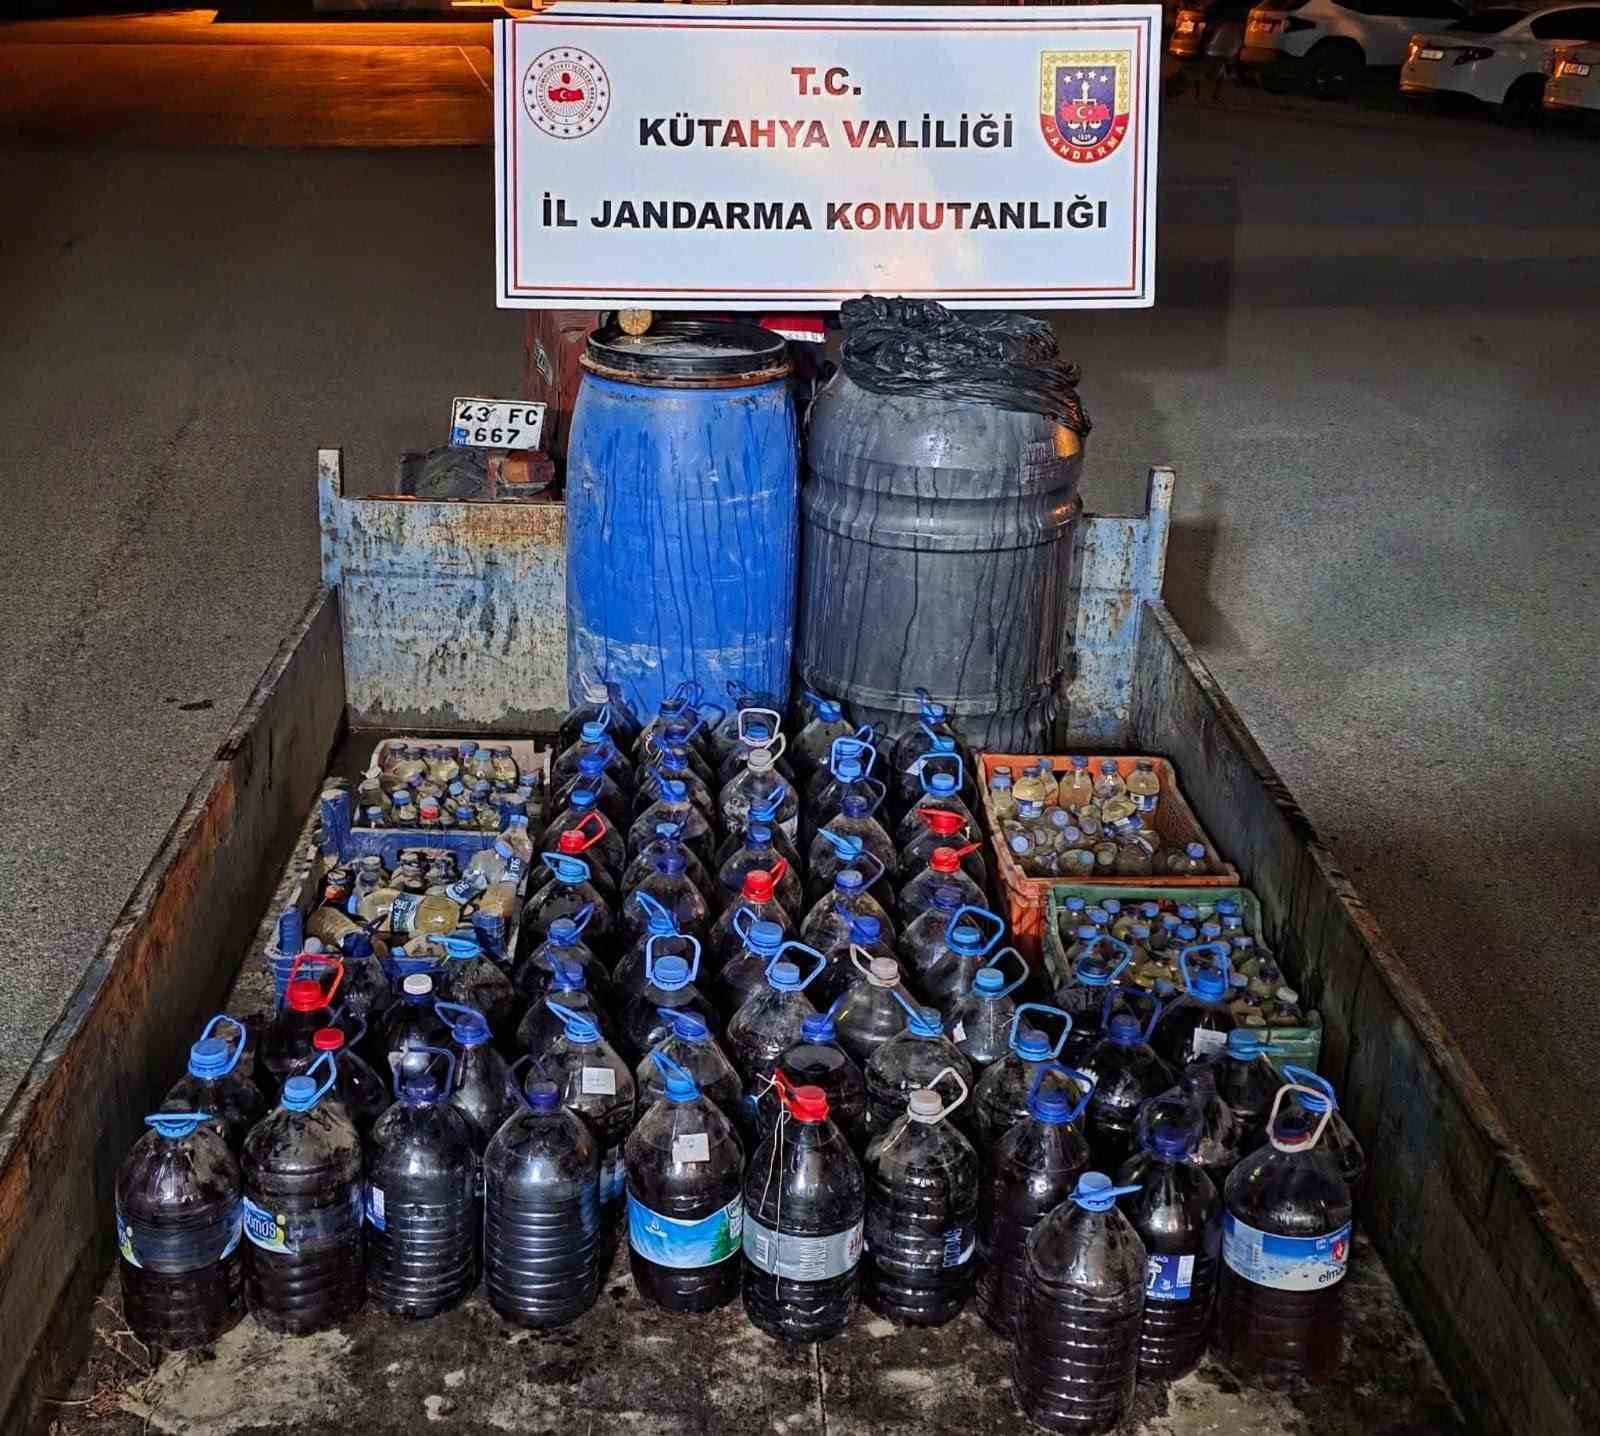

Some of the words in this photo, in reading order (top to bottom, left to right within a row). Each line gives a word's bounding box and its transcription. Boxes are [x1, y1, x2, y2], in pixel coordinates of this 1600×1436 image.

[791, 67, 861, 95] T.C.
[639, 112, 830, 148] KÜTAHYA
[842, 113, 1013, 148] VALİLİĞİ
[1046, 125, 1125, 160] JANDARMA
[543, 191, 578, 227] İL
[590, 200, 812, 230] JANDARMA
[826, 194, 1107, 230] KOMUTANLIĞI
[460, 406, 490, 422] 43
[509, 408, 538, 426] FC
[475, 428, 520, 444] 667
